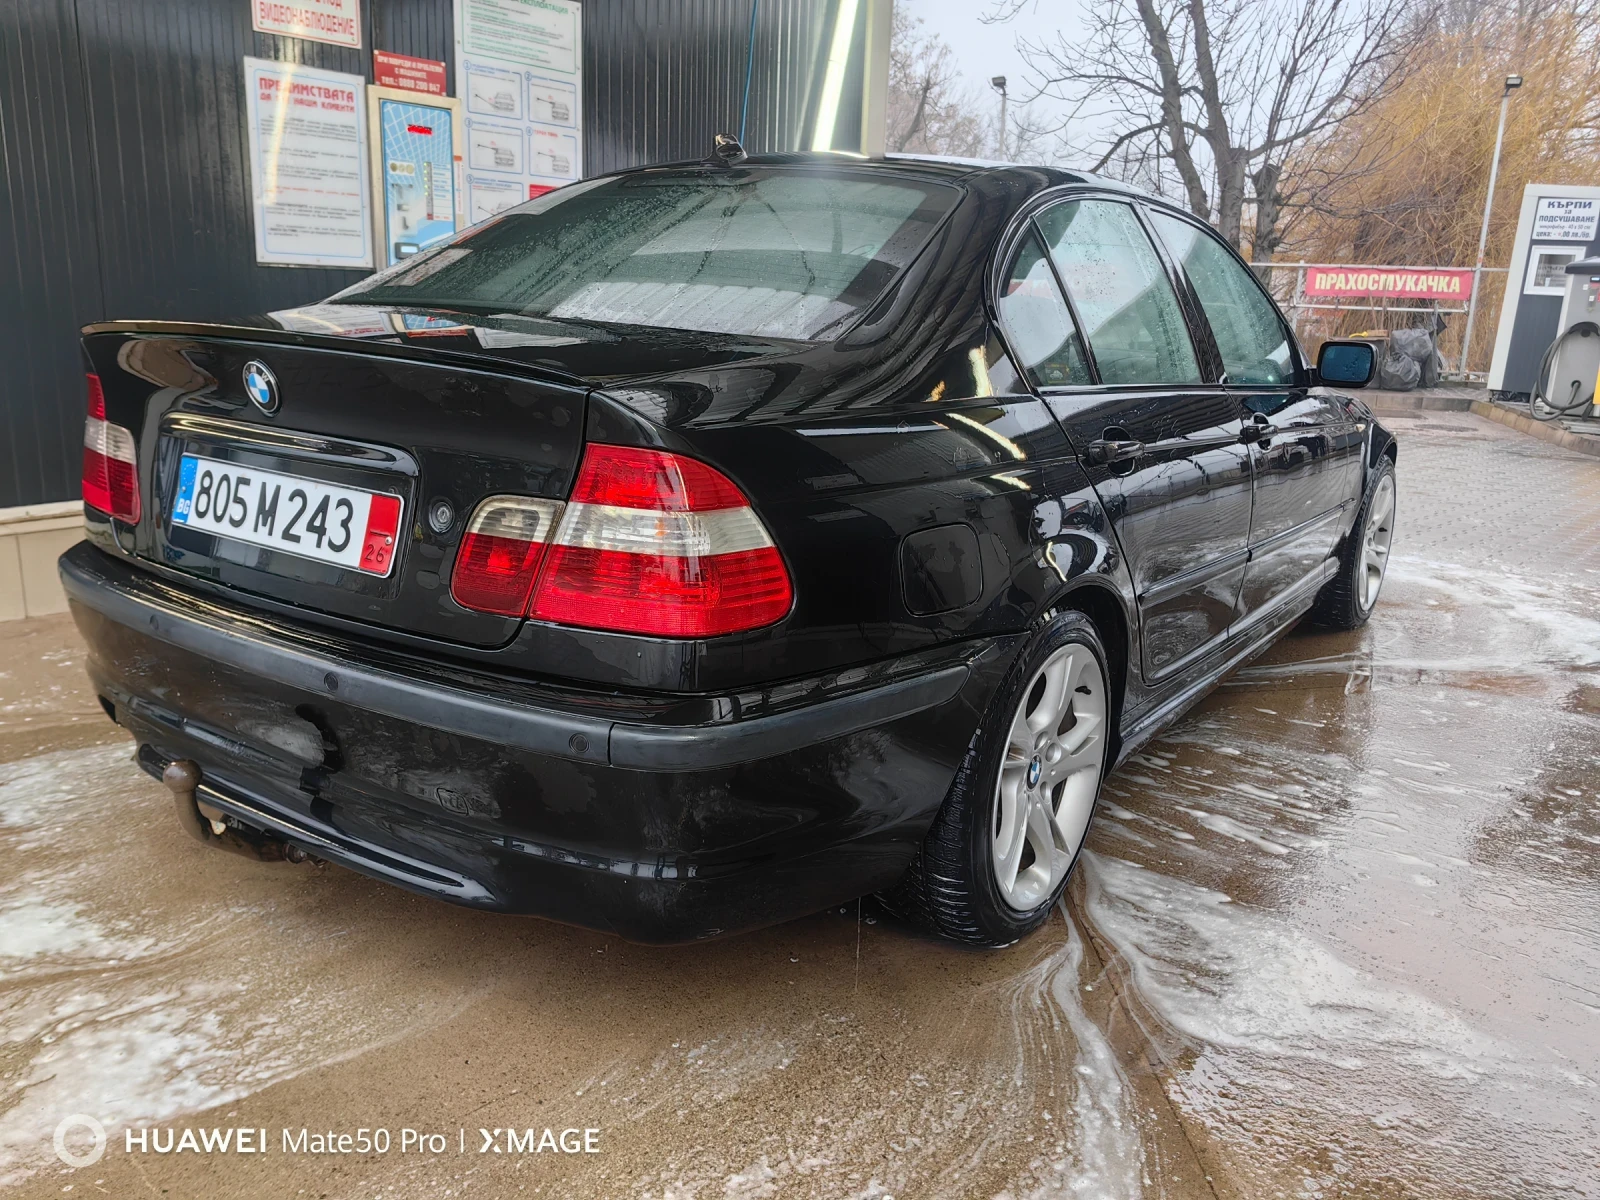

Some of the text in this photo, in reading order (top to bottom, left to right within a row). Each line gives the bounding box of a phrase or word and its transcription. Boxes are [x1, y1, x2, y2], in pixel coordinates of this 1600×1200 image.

[259, 2, 355, 36] ВИДЕОНАБЛЮДЕНИЕ
[259, 77, 355, 103] ПРЕИМСТВАТА
[1547, 201, 1593, 209] КЪРПИ
[1538, 215, 1596, 223] ПОДСУШАВАНЕ
[1315, 273, 1460, 293] ПРАХОСМУКАЧКА
[176, 497, 191, 515] BG
[365, 543, 385, 563] 26
